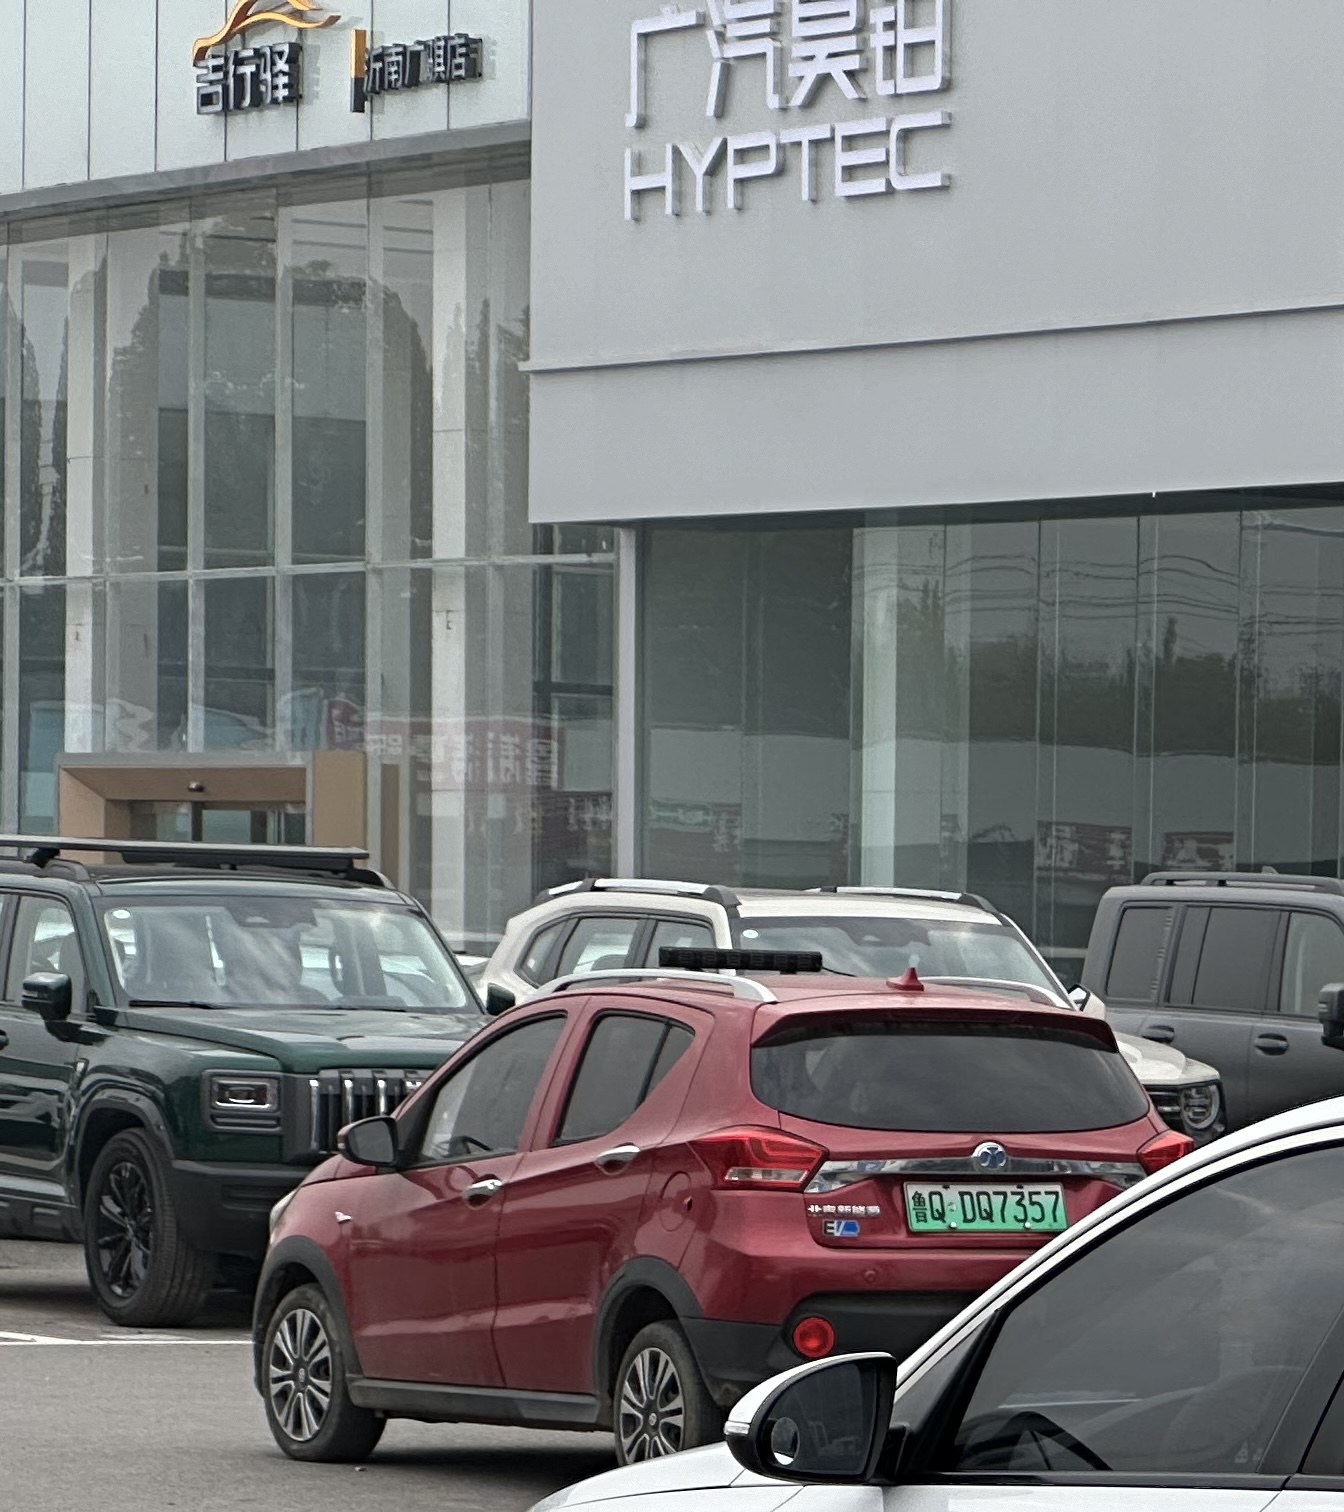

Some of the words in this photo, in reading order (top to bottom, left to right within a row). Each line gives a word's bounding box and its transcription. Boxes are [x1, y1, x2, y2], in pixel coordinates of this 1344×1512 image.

[624, 111, 951, 221] HYPTEC
[911, 1191, 945, 1223] 鲁Q
[962, 1191, 1060, 1225] DQ7357
